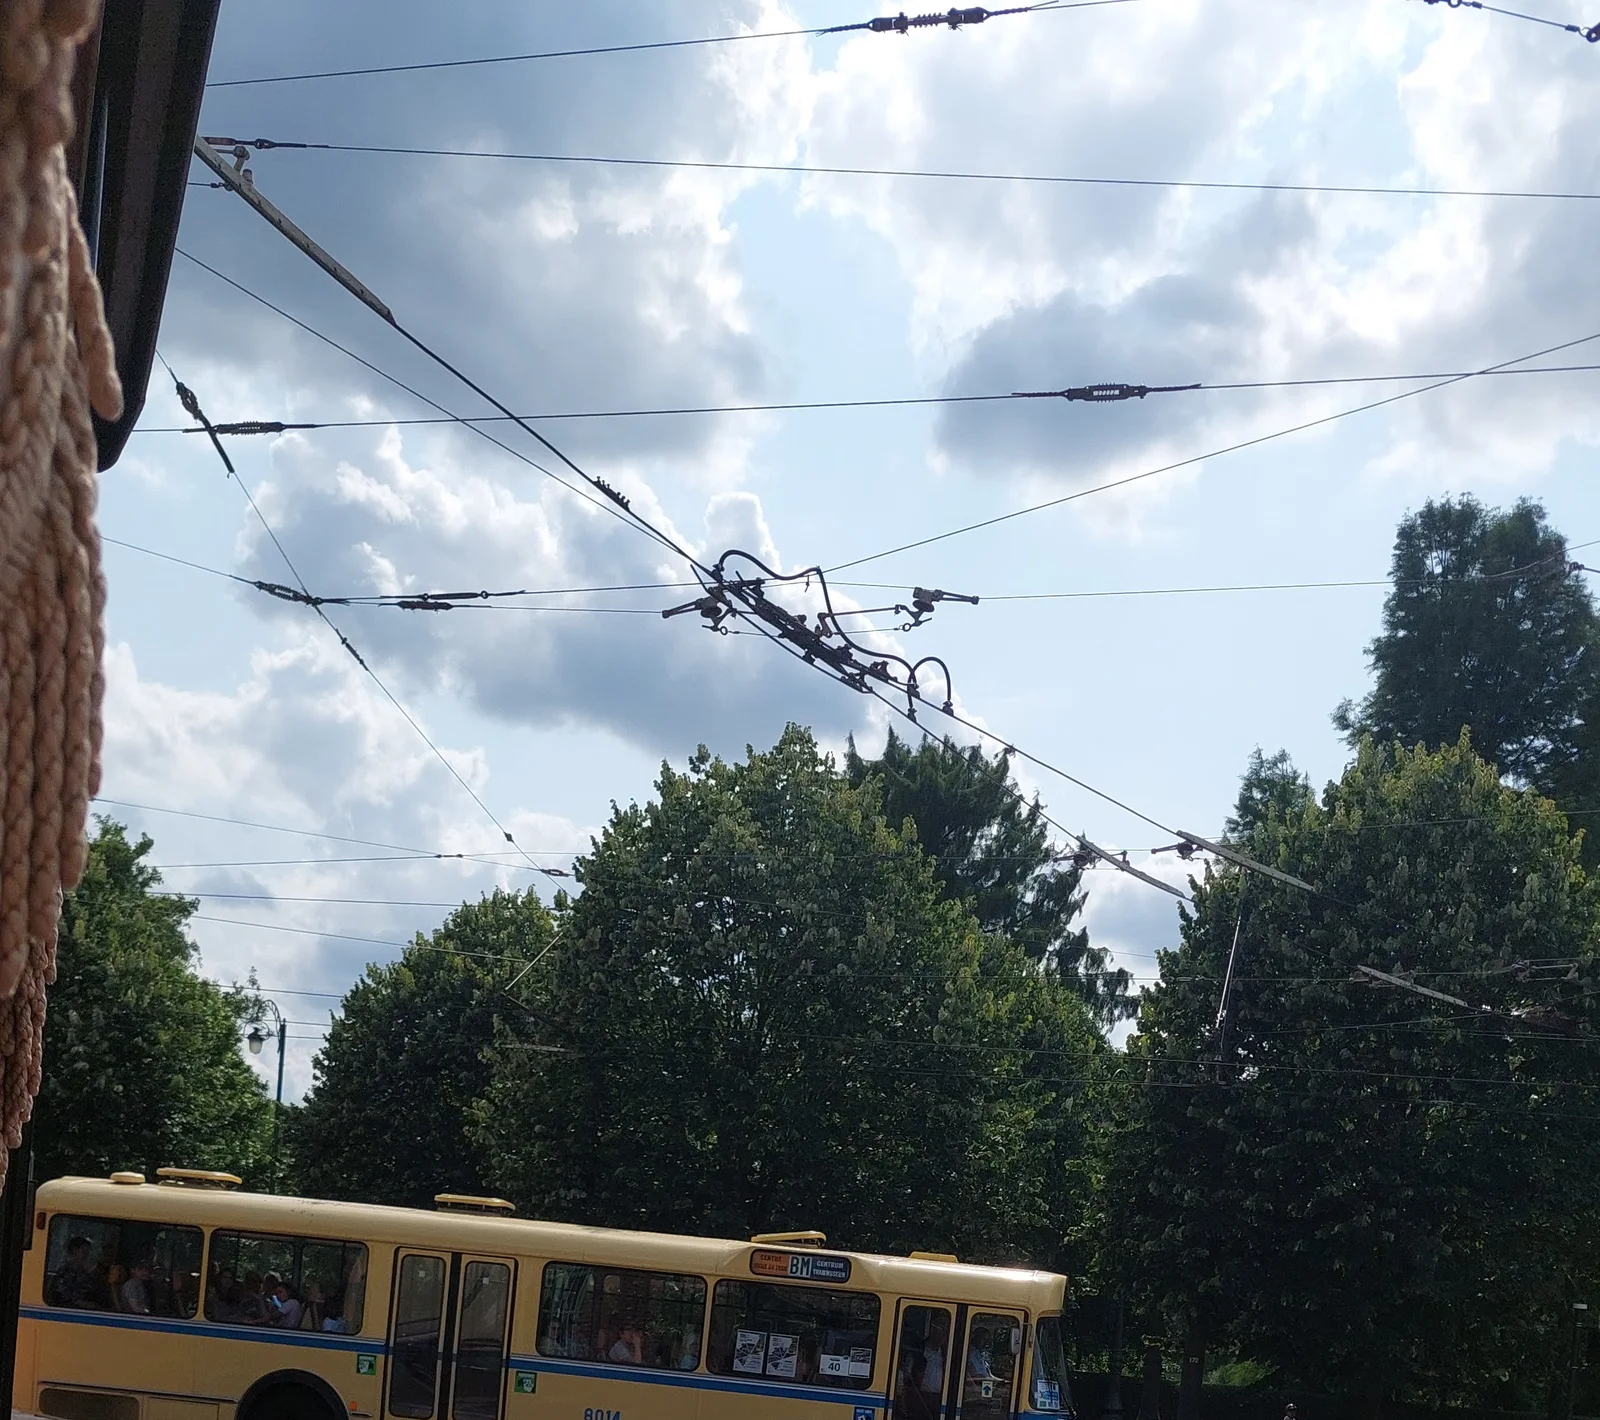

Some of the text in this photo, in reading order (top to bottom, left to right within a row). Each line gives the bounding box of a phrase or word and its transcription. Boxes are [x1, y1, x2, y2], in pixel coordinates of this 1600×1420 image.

[790, 1256, 811, 1276] BM
[816, 1260, 844, 1268] CENTRUM
[828, 1362, 841, 1372] 40
